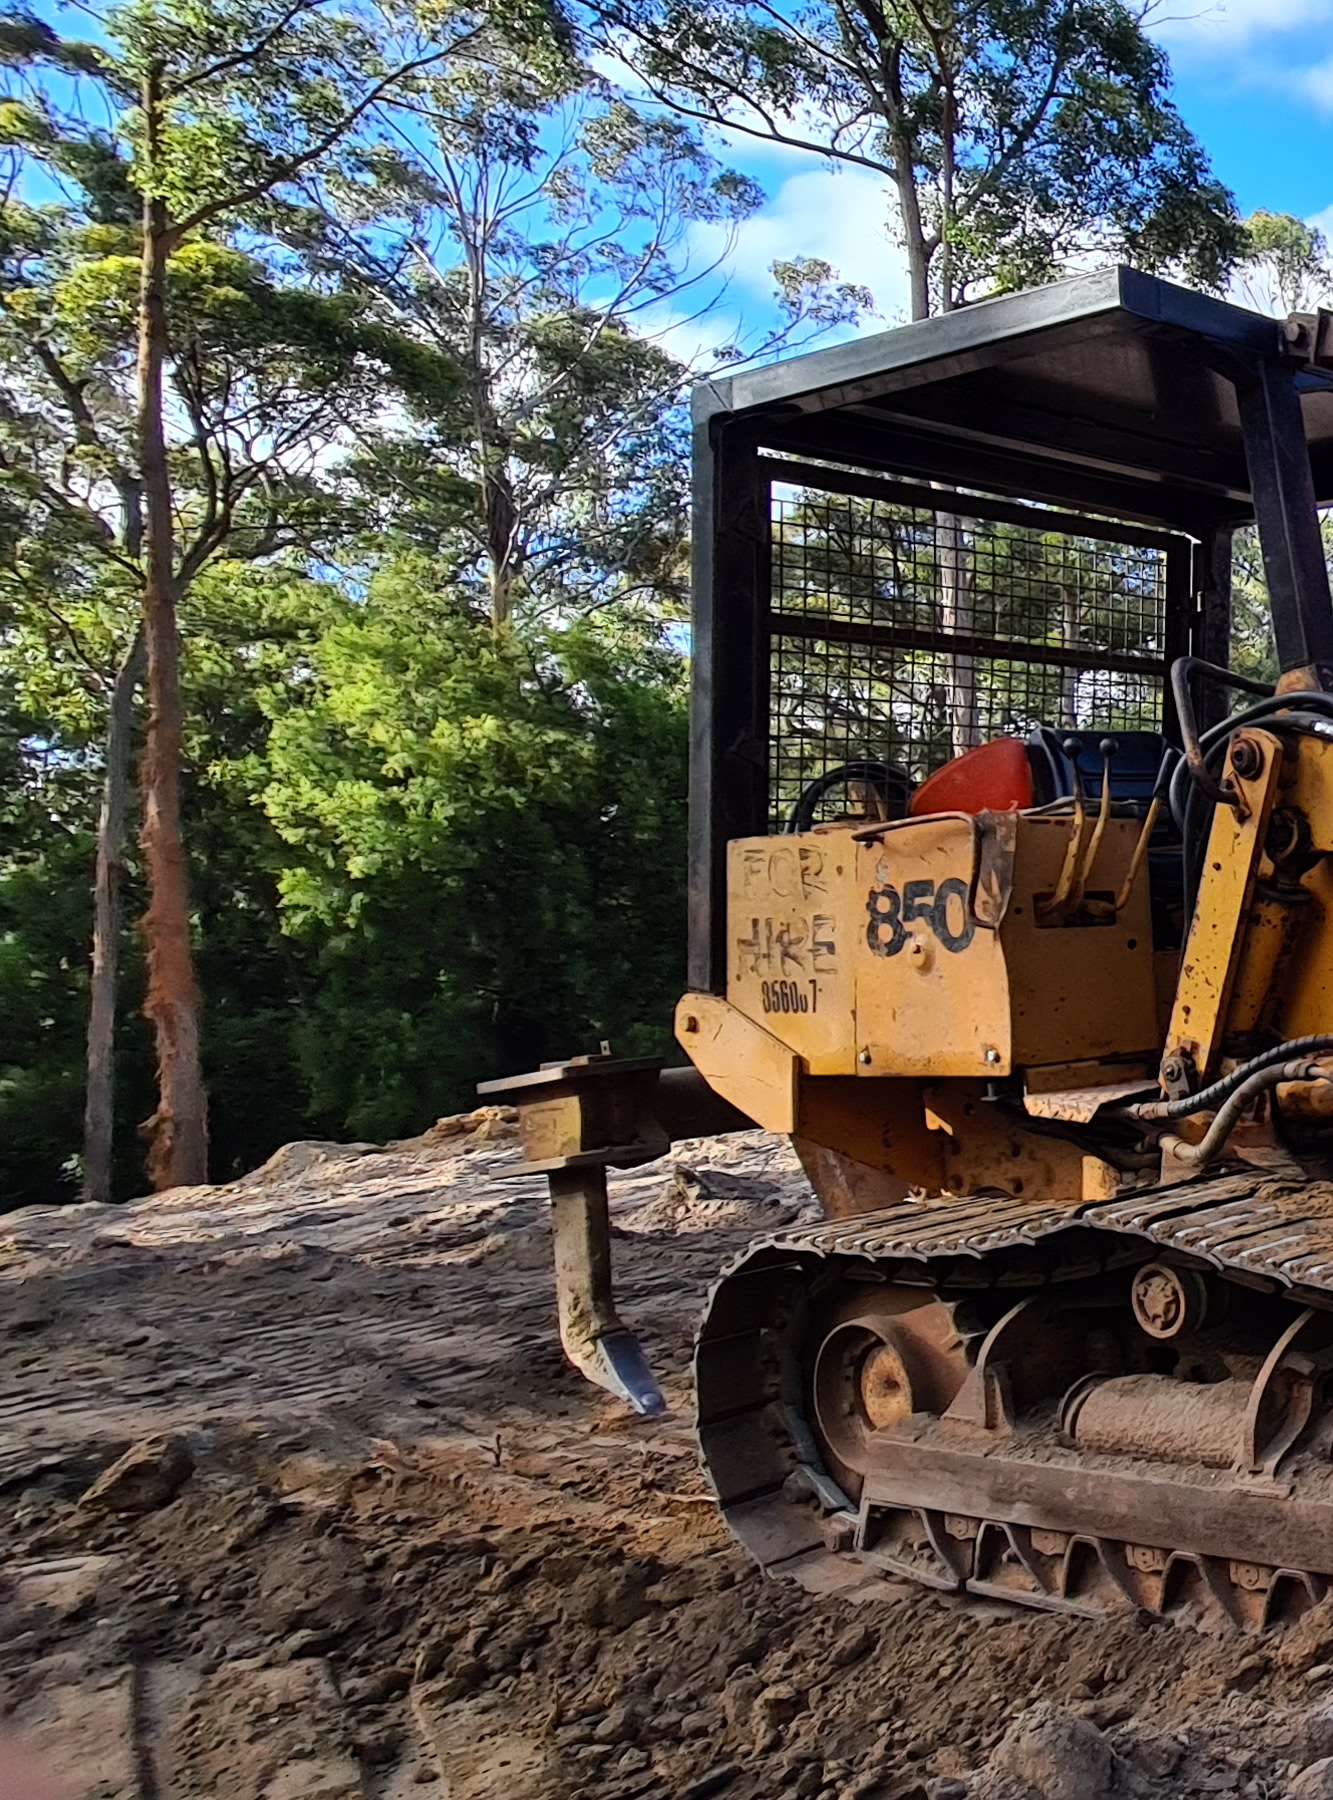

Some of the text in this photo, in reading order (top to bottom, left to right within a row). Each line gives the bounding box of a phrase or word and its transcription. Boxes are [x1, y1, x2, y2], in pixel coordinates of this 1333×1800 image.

[742, 845, 828, 899] FOR
[737, 914, 837, 976] HIRE
[866, 878, 976, 957] 850
